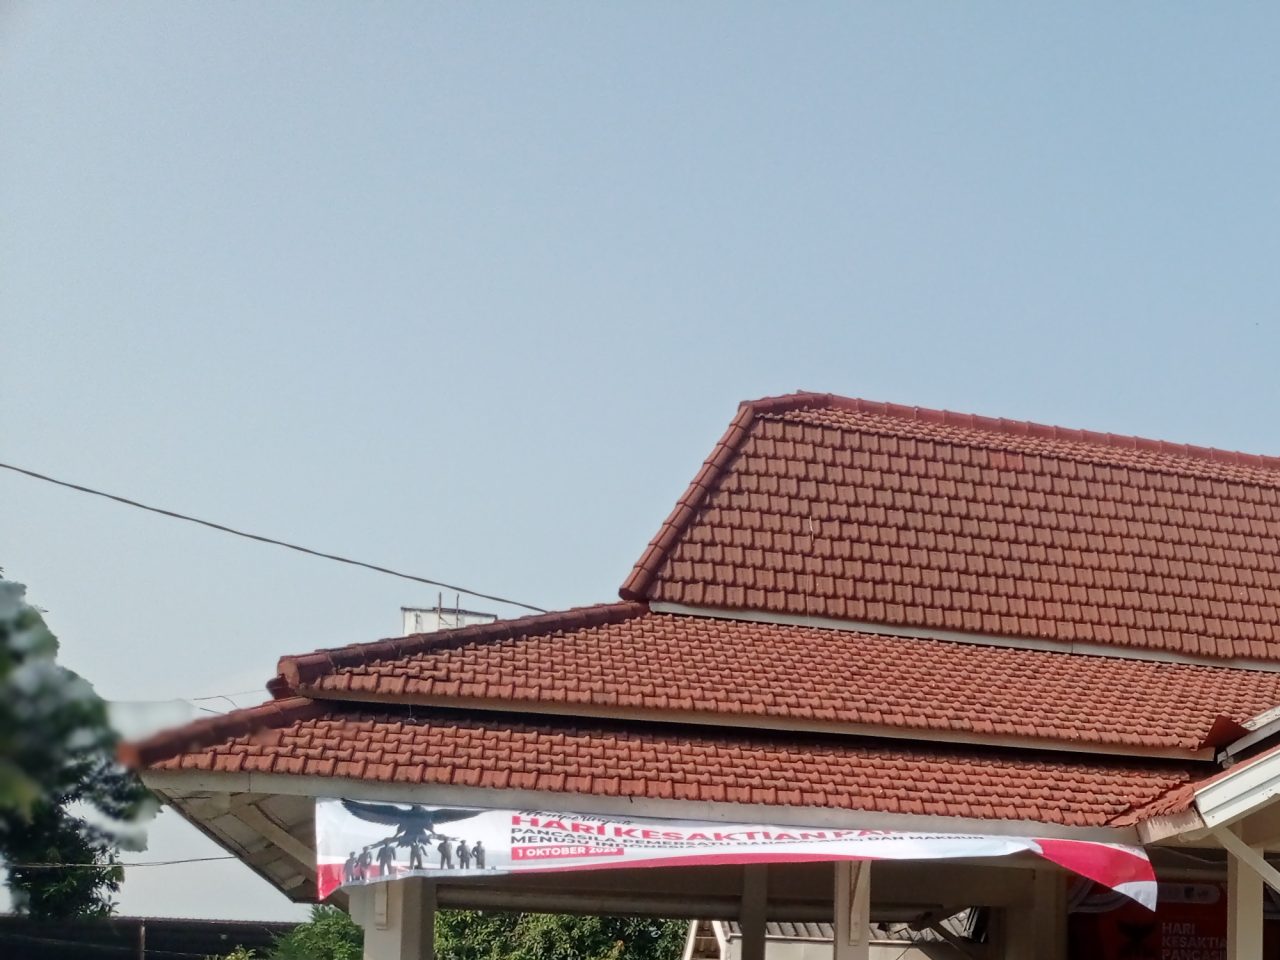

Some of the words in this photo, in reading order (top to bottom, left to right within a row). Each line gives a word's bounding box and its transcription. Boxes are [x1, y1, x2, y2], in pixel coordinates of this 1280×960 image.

[511, 815, 606, 836] HARI
[613, 826, 827, 842] KESAKTIAN
[510, 828, 616, 843] PANCASILA
[510, 835, 590, 845] MENUJU
[525, 846, 586, 857] OKTOBER
[1161, 922, 1196, 935] HARI
